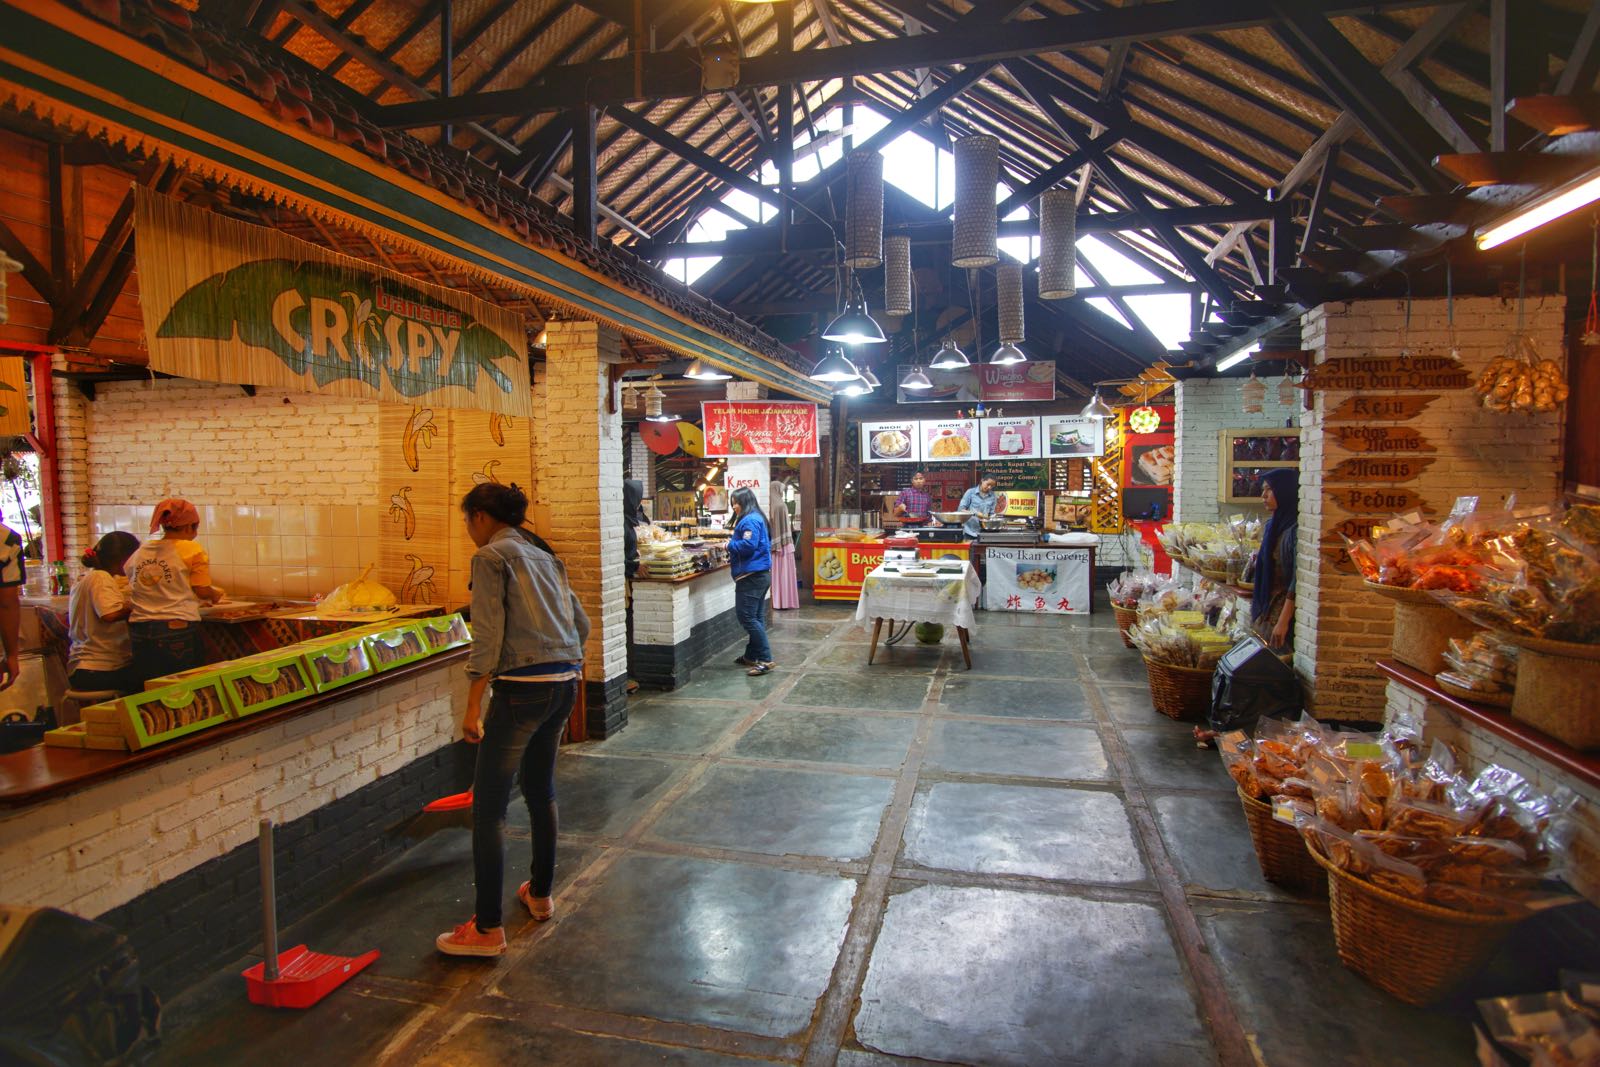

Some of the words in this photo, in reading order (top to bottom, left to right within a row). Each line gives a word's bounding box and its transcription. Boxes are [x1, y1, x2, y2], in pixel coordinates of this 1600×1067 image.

[376, 284, 462, 330] banana
[271, 287, 462, 378] CRISPY
[1369, 372, 1402, 389] dan
[1353, 398, 1404, 415] Keju
[1347, 460, 1410, 478] Manis
[727, 475, 760, 489] KASSA
[1349, 489, 1408, 508] Pedas
[851, 552, 884, 566] BAKS
[988, 548, 1013, 559] Baso
[1017, 549, 1042, 561] Ikan
[1045, 550, 1089, 564] Goreng
